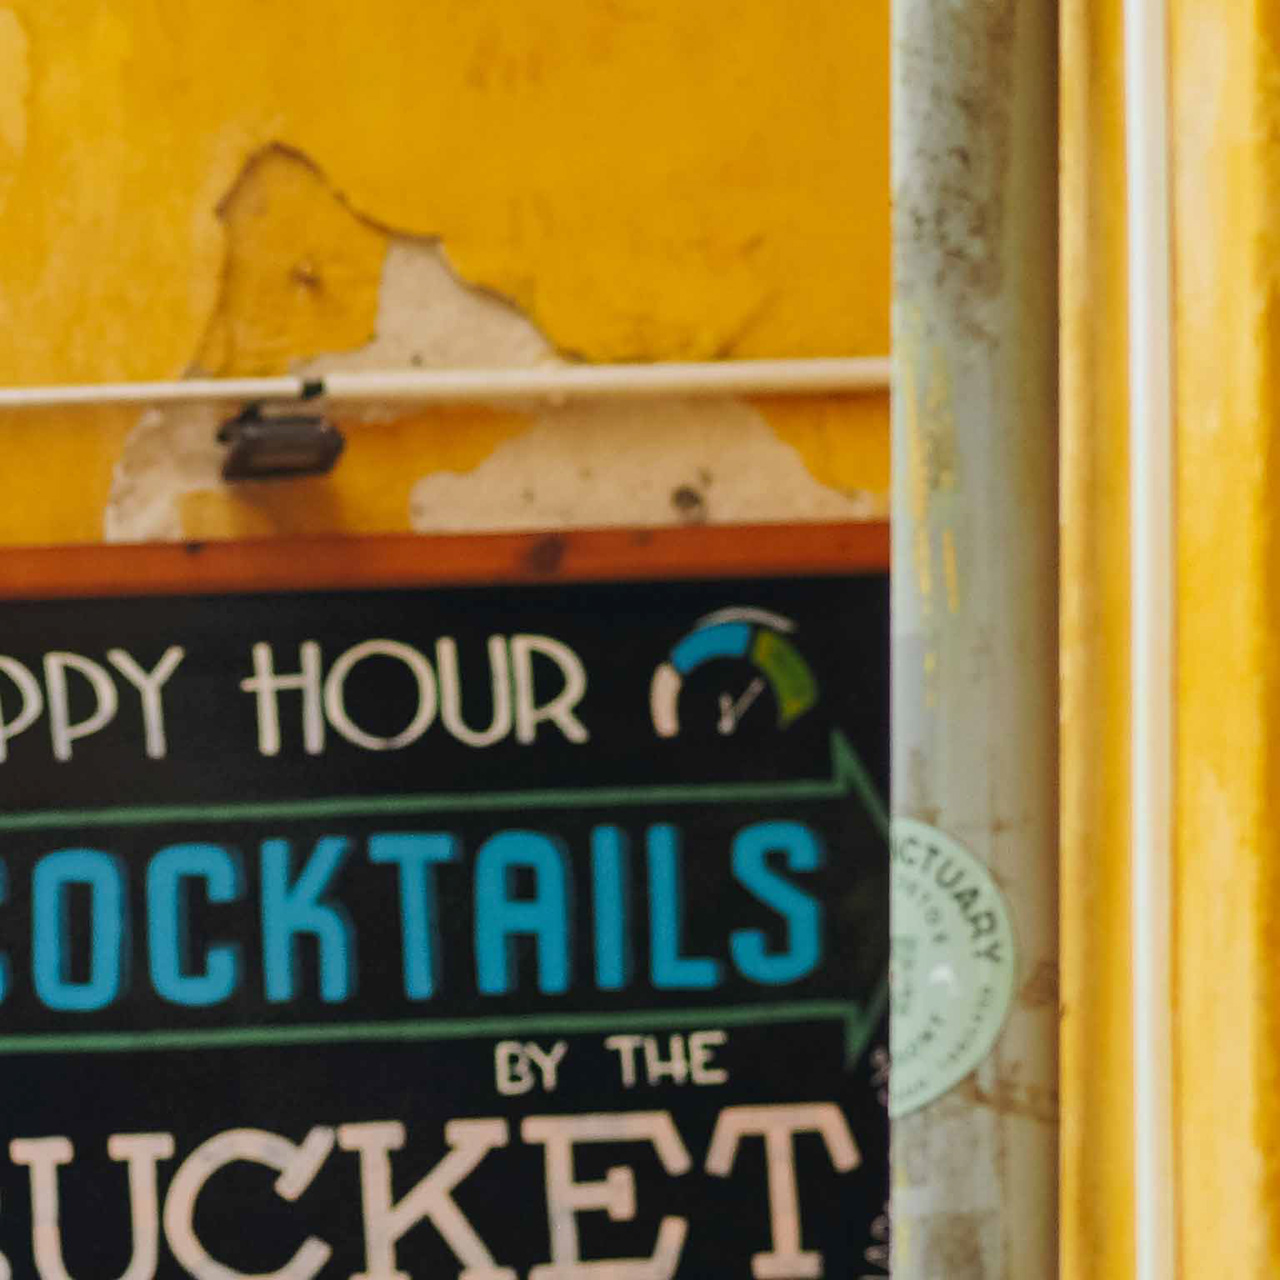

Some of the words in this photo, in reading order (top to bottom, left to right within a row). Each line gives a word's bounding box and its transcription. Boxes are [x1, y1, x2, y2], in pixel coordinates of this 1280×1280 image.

[240, 633, 590, 757] HOUR
[892, 837, 1003, 963] CTUARY
[494, 1039, 569, 1095] BY
[605, 1029, 730, 1088] THE
